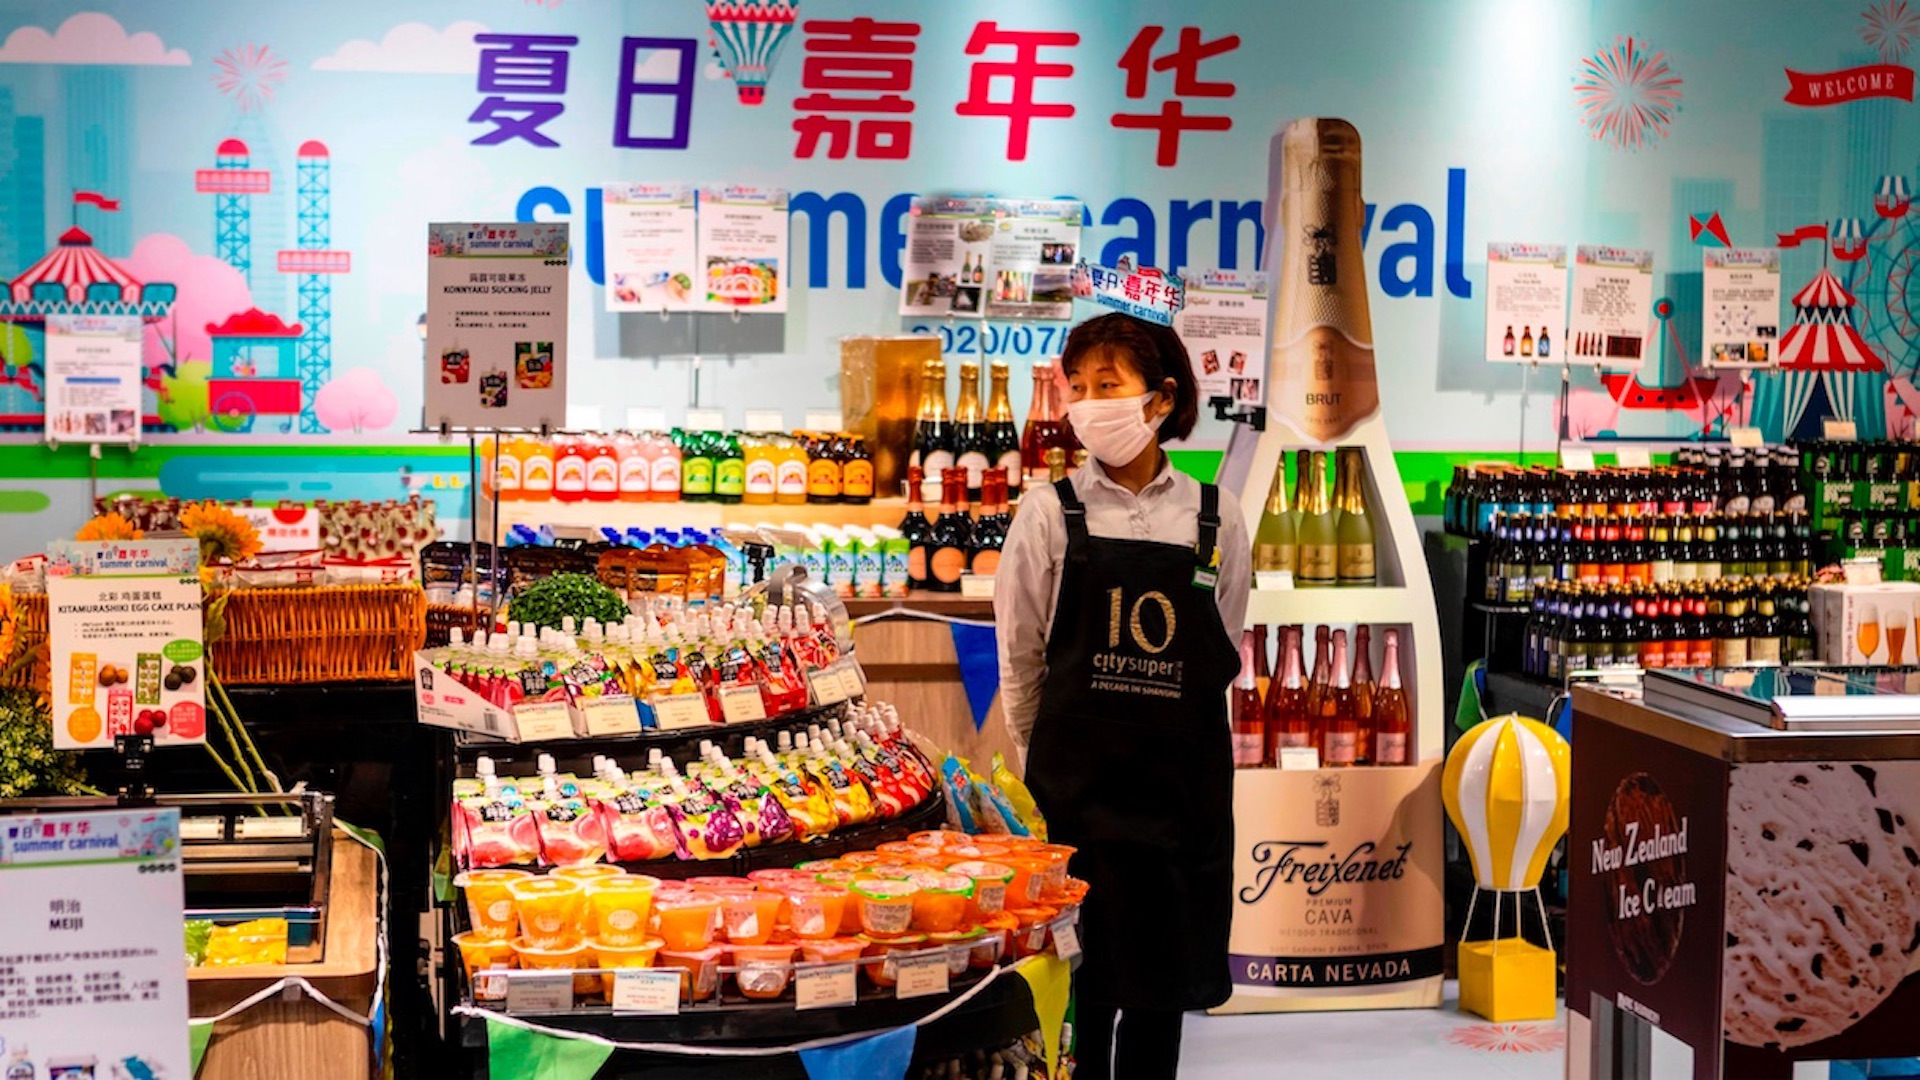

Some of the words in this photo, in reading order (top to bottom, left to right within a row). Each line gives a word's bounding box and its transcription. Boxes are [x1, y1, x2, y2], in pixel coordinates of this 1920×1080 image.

[468, 17, 1242, 168] 夏日嘉年华
[1808, 73, 1895, 99] WELCOME
[1053, 168, 1471, 298] arnal
[470, 240, 500, 249] summer
[503, 238, 533, 248] carnival
[443, 286, 489, 294] KONNYAKU
[491, 286, 529, 294] SUCKING
[530, 286, 552, 295] JELLY
[1091, 267, 1180, 311] 夏日嘉年华
[1096, 292, 1131, 312] summer
[1133, 303, 1169, 325] carnival
[1306, 393, 1342, 405] BRUT
[100, 560, 132, 569] summer
[135, 557, 168, 567] carnival
[58, 604, 129, 614] KITAMURASHIKI
[131, 603, 149, 612] EGG
[151, 602, 174, 612] CAKE
[1107, 586, 1176, 654] 10
[13, 838, 65, 853] summer
[69, 833, 119, 850] carnival
[1592, 839, 1623, 875] New
[1624, 816, 1688, 867] Zealand
[1239, 841, 1413, 904] Freixenet
[50, 900, 81, 914] 明治
[1306, 898, 1353, 906] PREMIUM
[1618, 884, 1640, 920] Ice
[50, 917, 83, 930] MEIJI
[1305, 908, 1354, 925] CAVA
[1320, 926, 1378, 937] TRADICIONAL
[1246, 961, 1315, 983] CARTA
[1324, 958, 1411, 983] NEVADA
